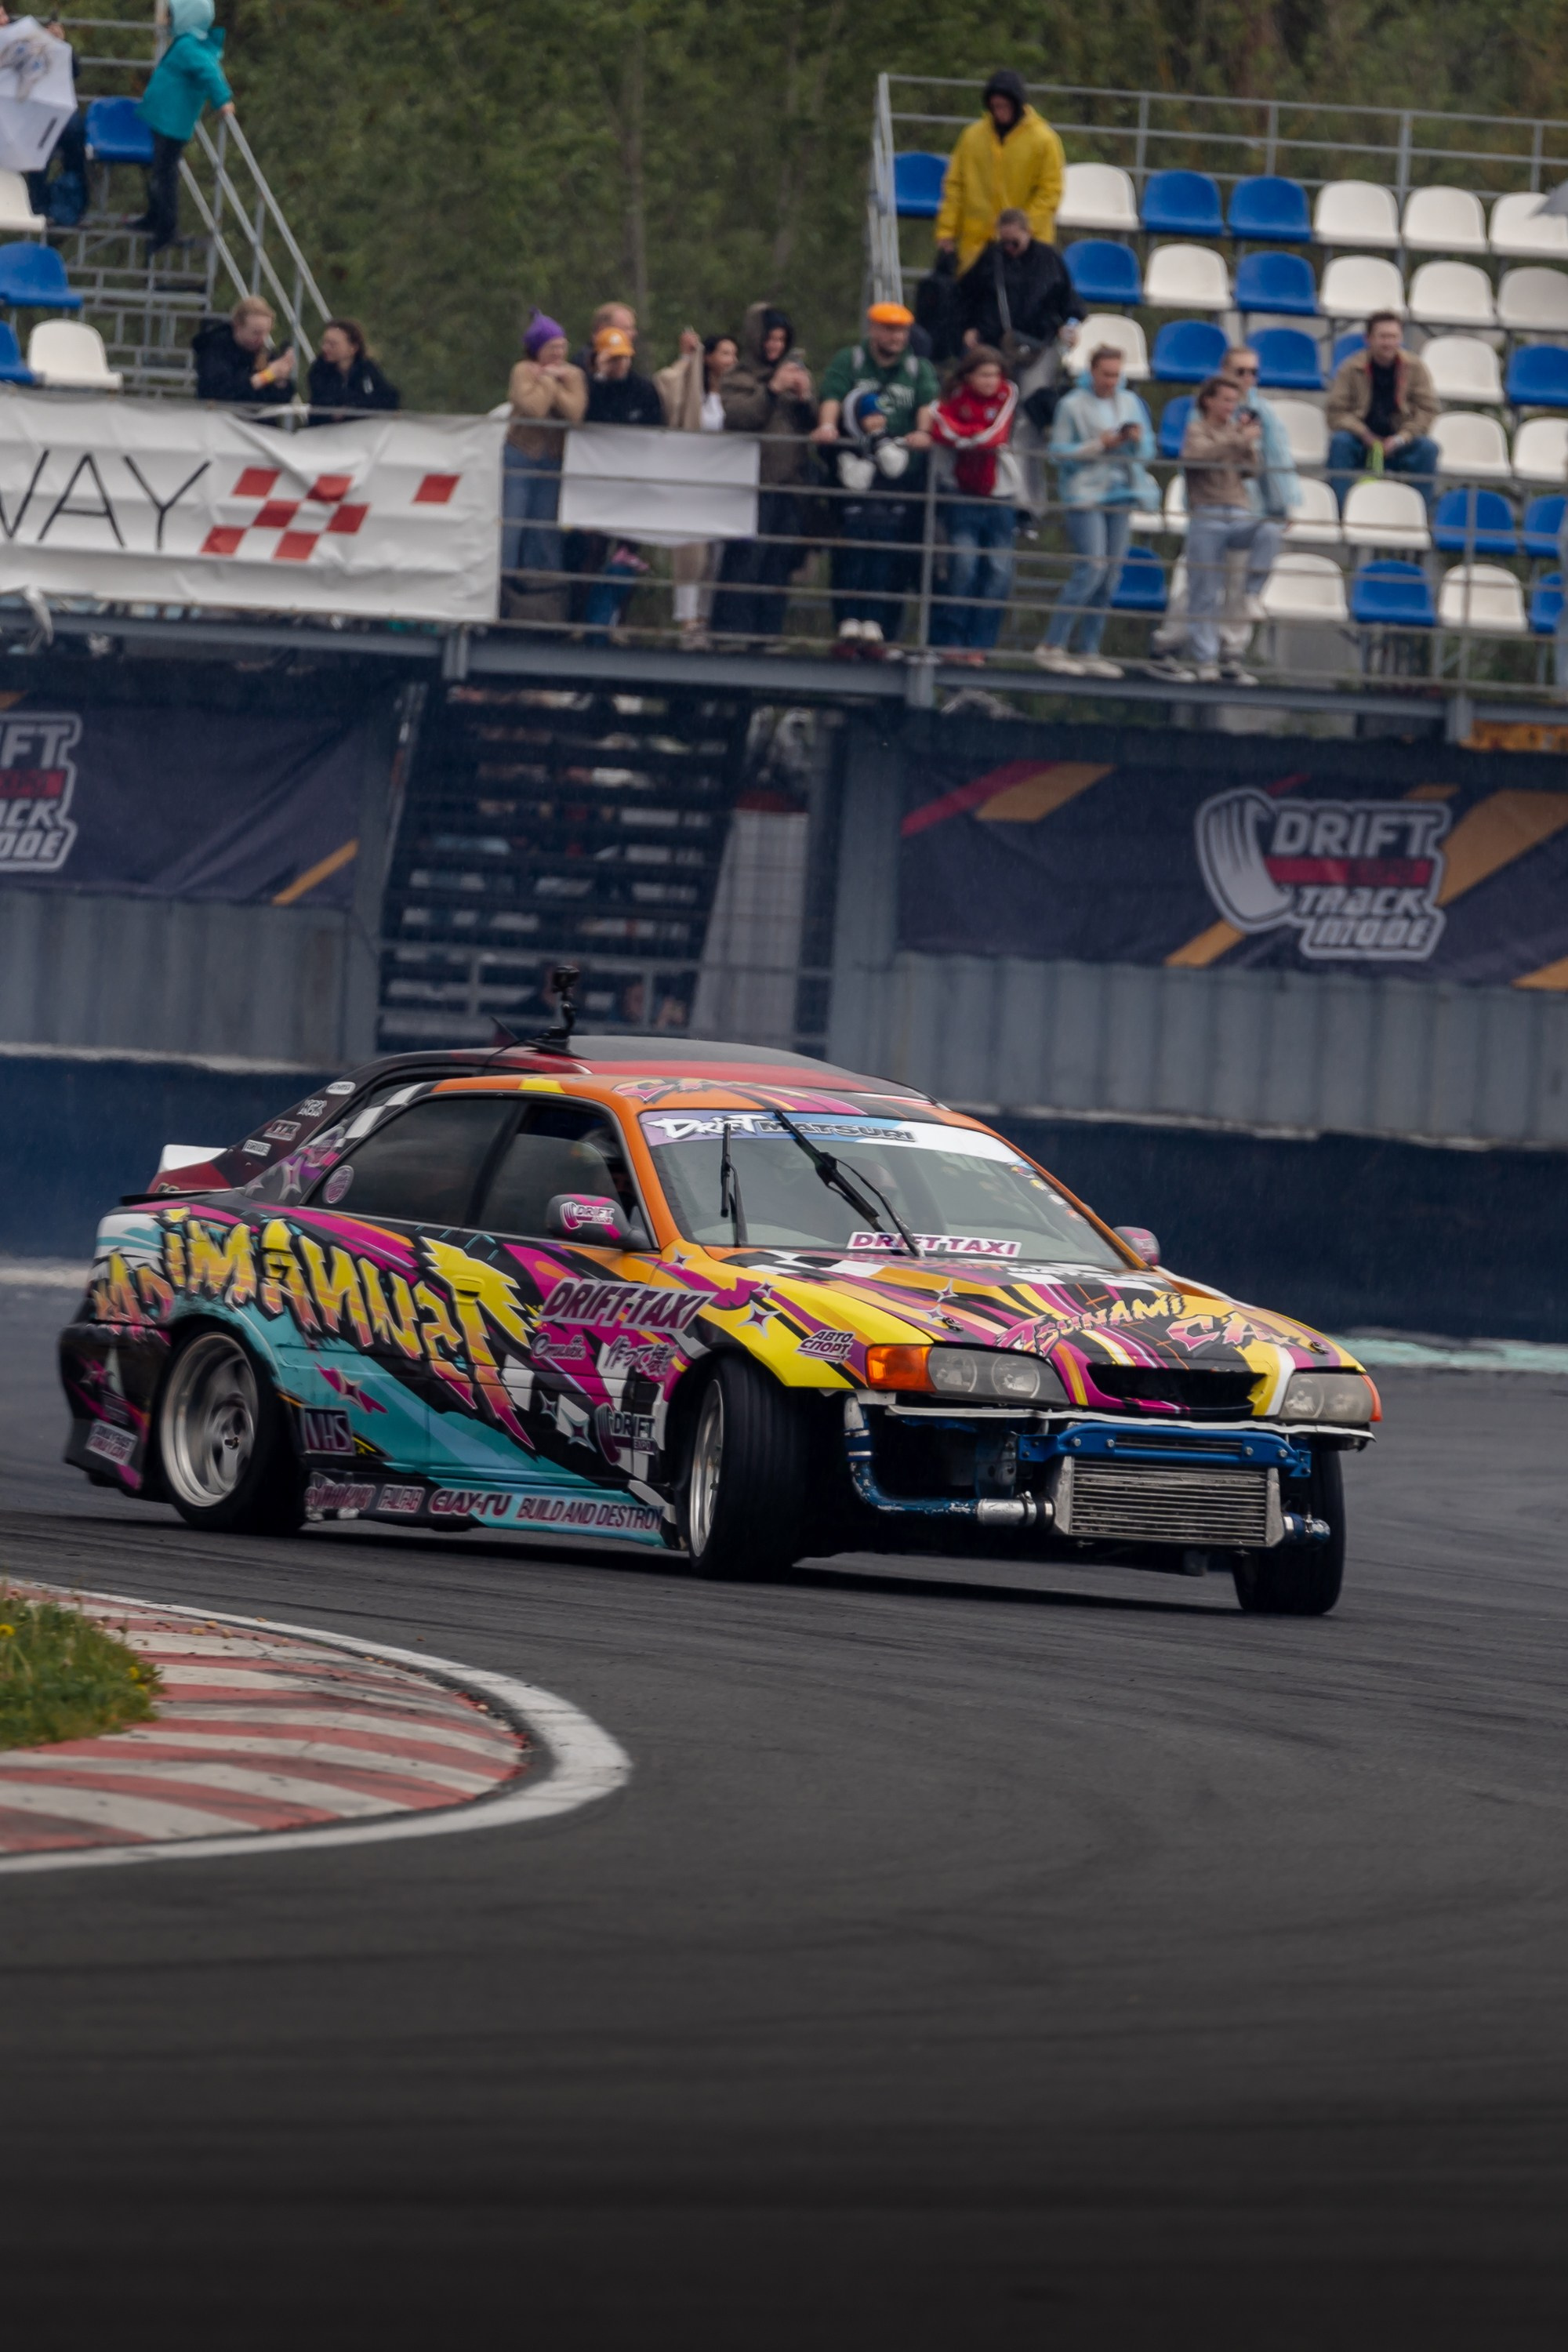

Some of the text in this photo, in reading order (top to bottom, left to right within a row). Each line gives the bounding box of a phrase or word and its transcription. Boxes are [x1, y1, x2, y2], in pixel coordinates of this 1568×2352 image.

[1270, 811, 1436, 857] DRIFT
[1298, 887, 1425, 916] TRACK
[1314, 916, 1431, 948] MODE
[756, 1120, 918, 1142] MATSURI
[948, 1237, 1016, 1255] TAXI
[543, 1281, 711, 1329] DRIFT TAXI
[800, 1339, 851, 1354] СПОРТ
[812, 1331, 854, 1343] АВТО
[614, 1412, 655, 1439] DRIFT
[517, 1497, 666, 1530] BUILD AND DESTROY
